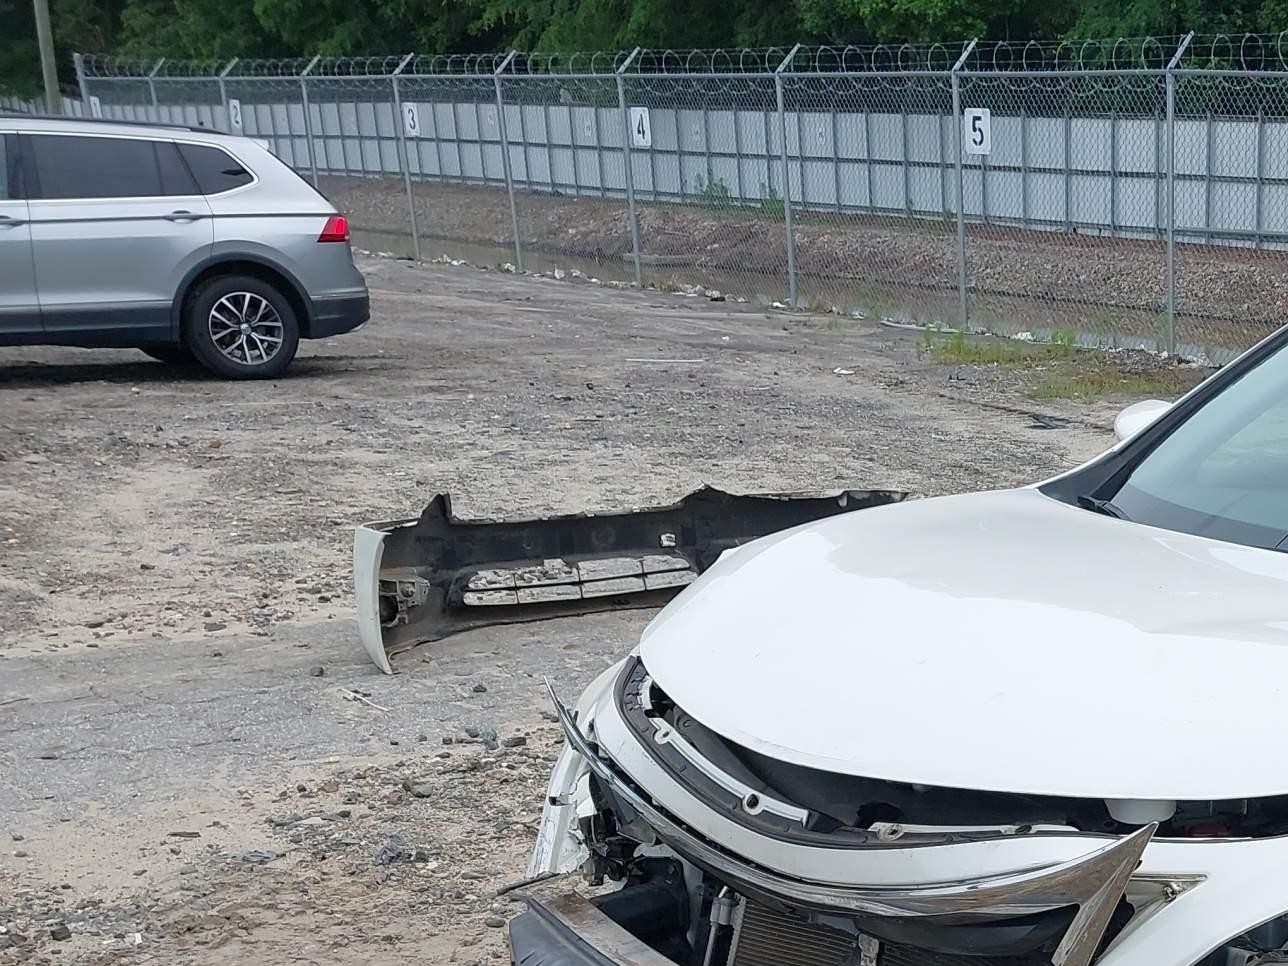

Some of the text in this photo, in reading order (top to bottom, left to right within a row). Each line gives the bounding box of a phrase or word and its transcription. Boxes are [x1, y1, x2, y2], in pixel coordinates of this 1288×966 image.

[233, 104, 240, 125] 2
[407, 108, 416, 130] 3
[637, 113, 645, 140] 4
[972, 115, 984, 146] 5
